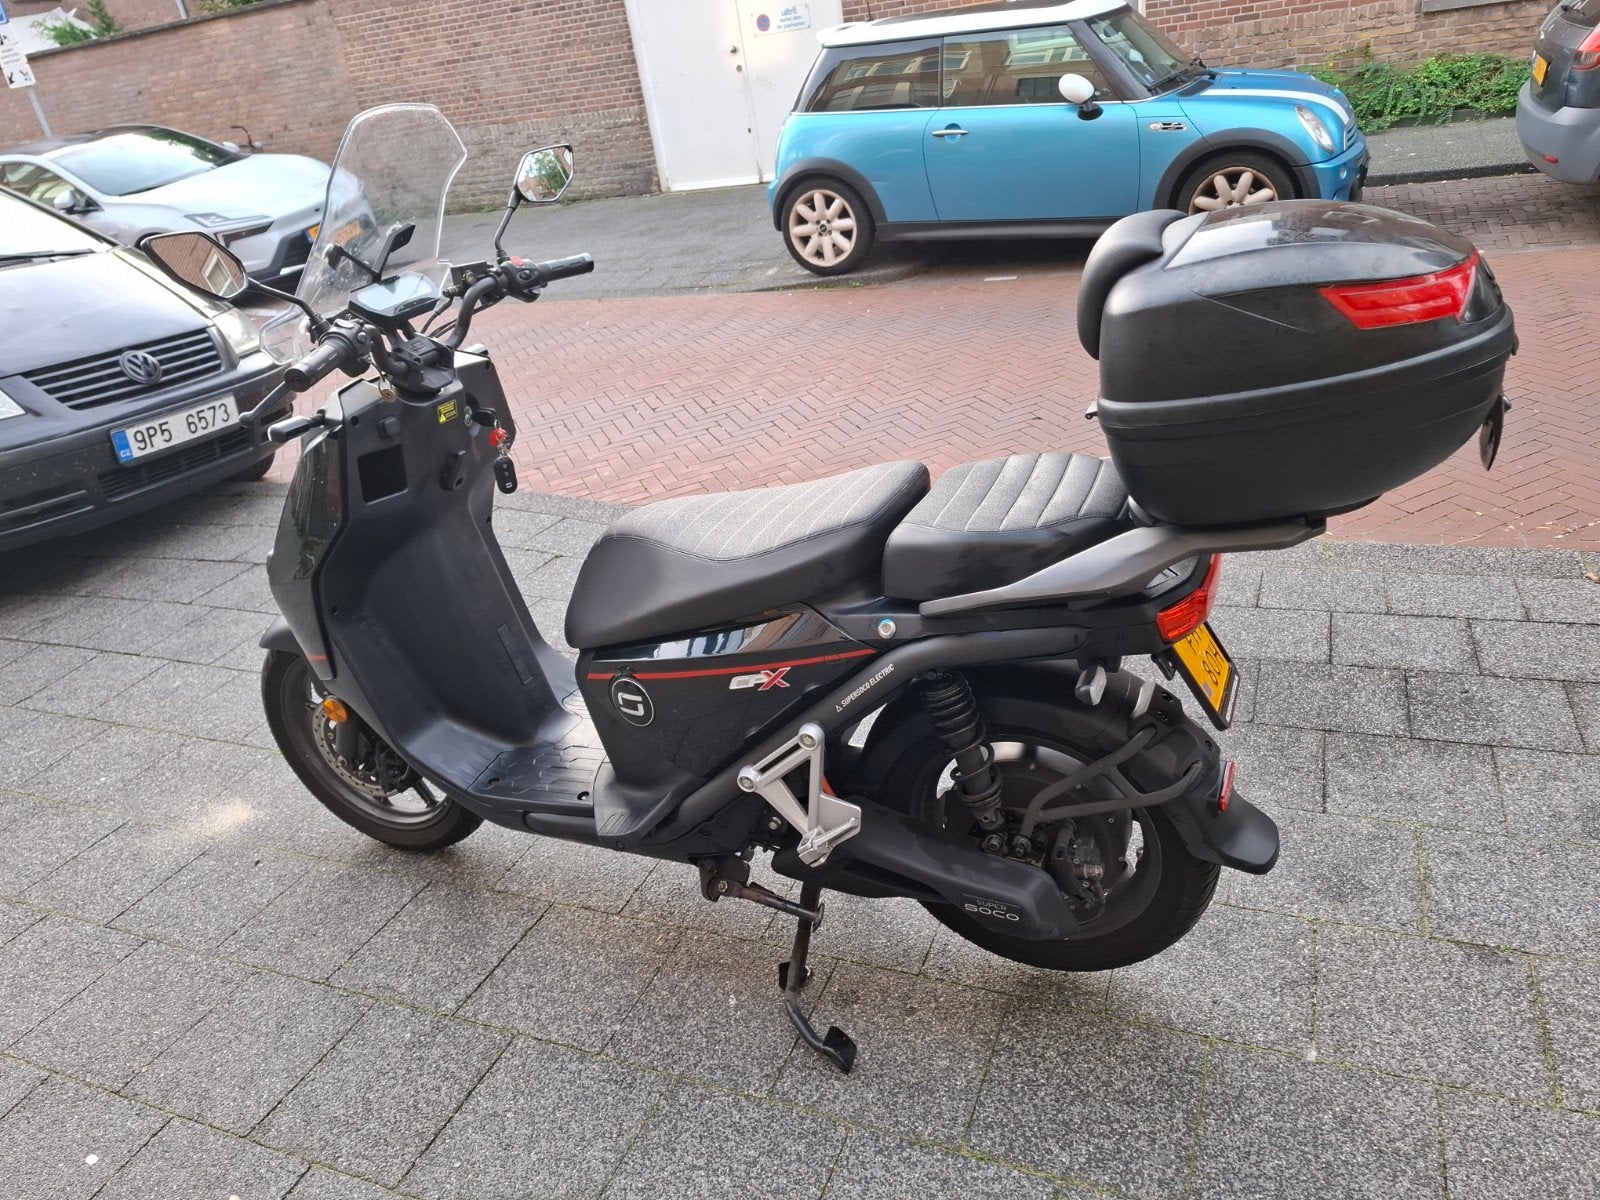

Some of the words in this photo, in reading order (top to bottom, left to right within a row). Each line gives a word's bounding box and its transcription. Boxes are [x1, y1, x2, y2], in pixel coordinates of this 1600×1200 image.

[133, 421, 173, 451] 9P5
[185, 403, 230, 434] 6573
[841, 682, 870, 707] SUPERSOCO
[869, 663, 895, 686] ELECTRIC
[965, 903, 1020, 921] SOCO
[977, 900, 1007, 911] SUPER
